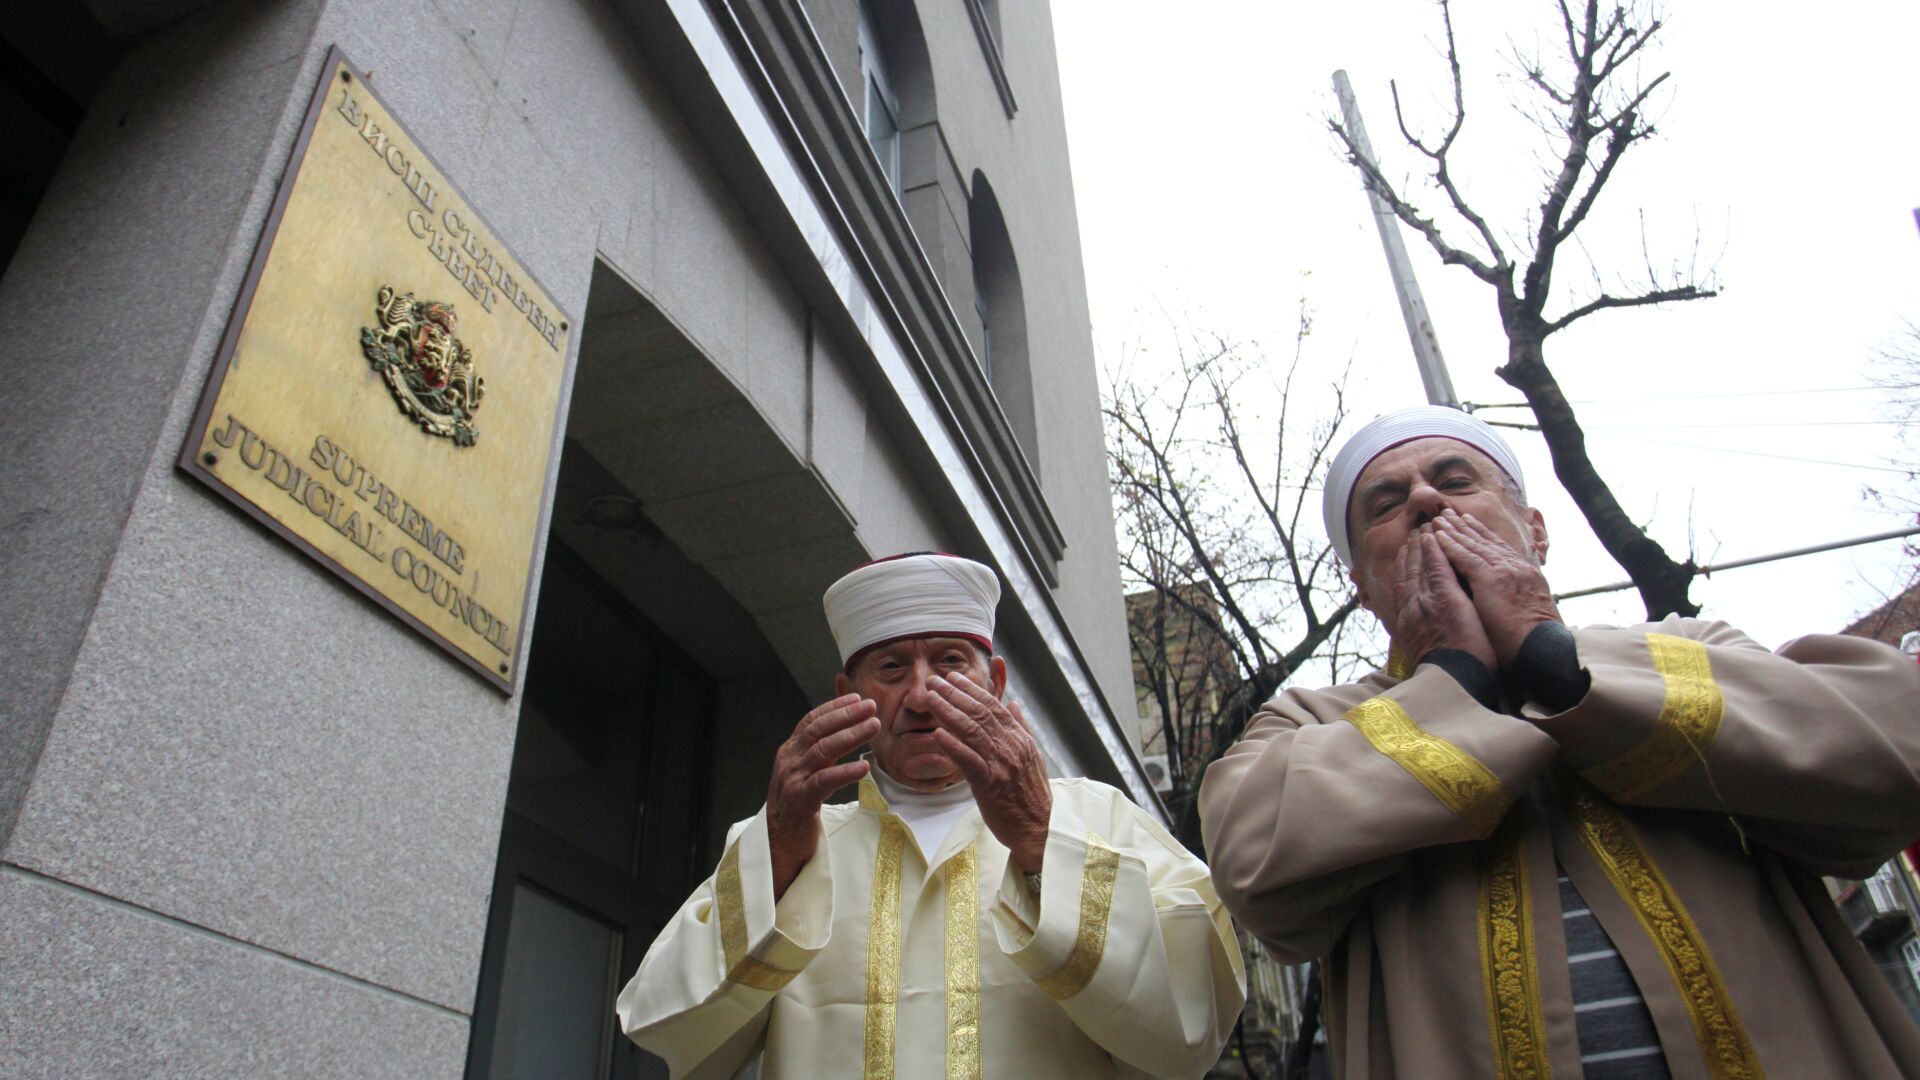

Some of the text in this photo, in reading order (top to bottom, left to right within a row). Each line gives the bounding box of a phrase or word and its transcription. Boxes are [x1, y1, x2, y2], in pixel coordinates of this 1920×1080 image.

[337, 89, 562, 352] ВИСШ СЪДЕБЕН
[407, 208, 498, 314] СЪВЕТ
[212, 414, 510, 656] JUDICIAL COUNCIL
[310, 434, 466, 575] SUPREME
